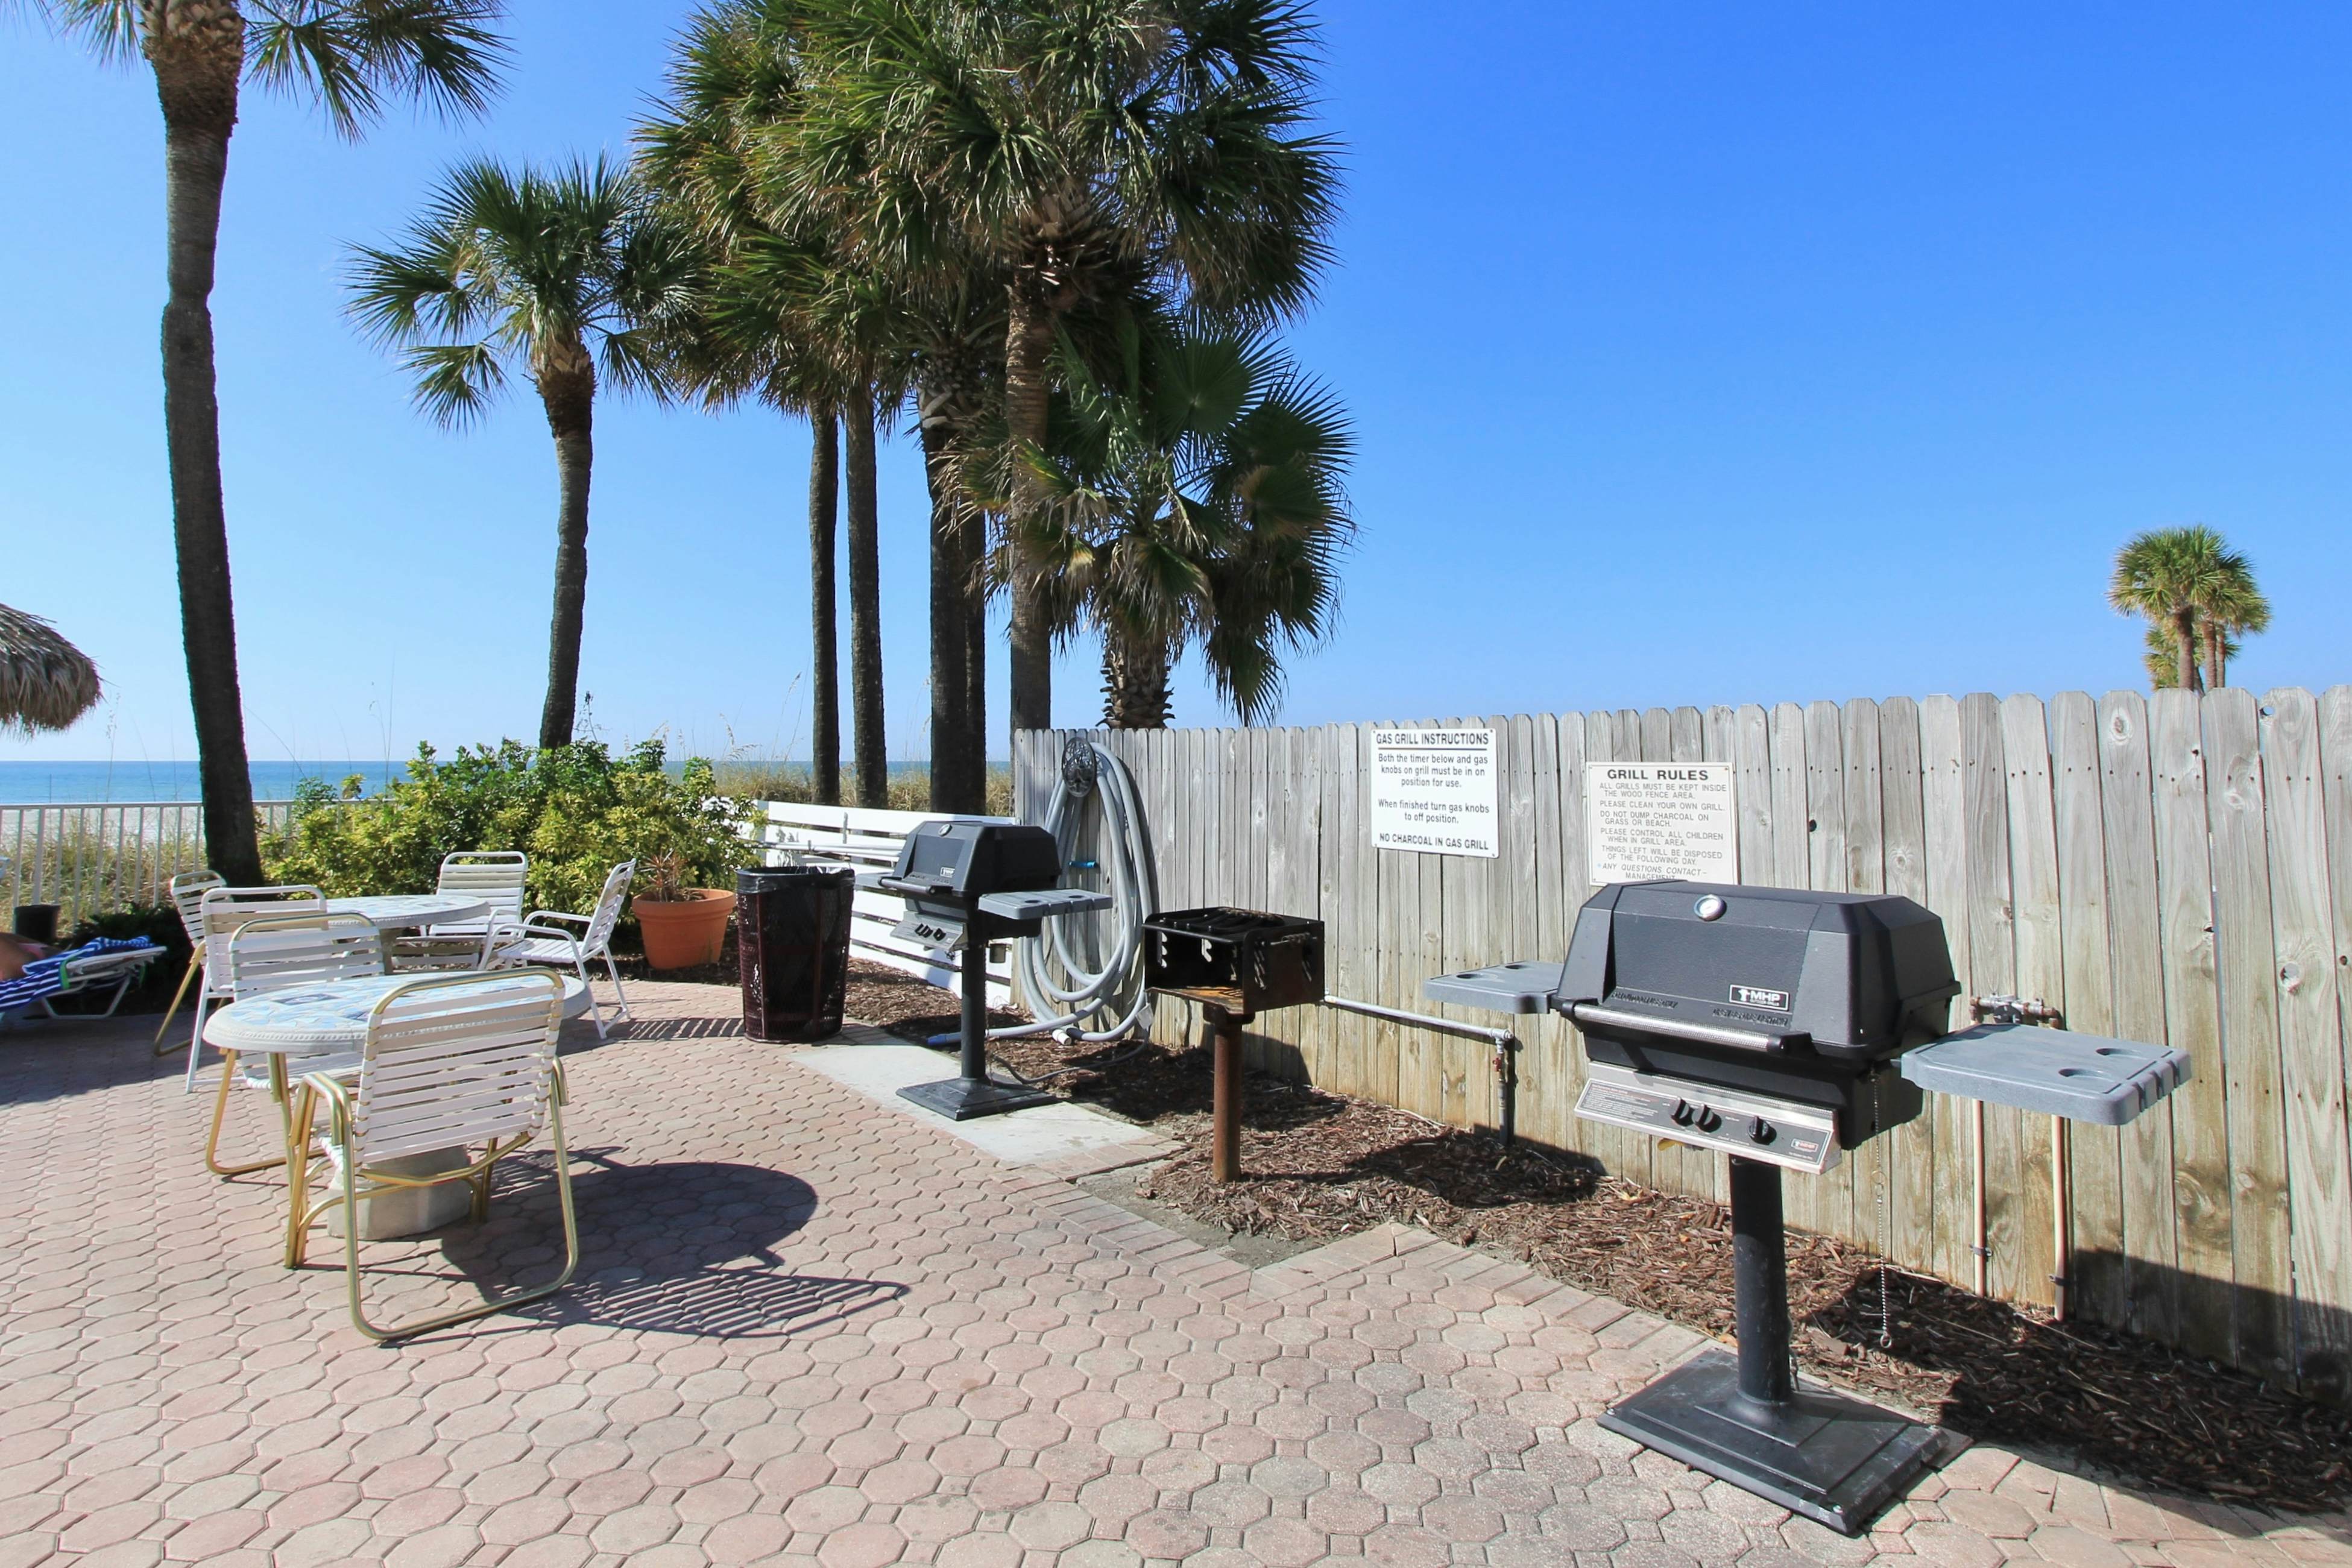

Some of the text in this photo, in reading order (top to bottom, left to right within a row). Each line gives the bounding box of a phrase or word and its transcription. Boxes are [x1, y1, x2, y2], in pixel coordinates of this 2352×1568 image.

[1376, 733, 1489, 745] GAS GRILL INSTRUCTIONS
[1378, 754, 1488, 766] Both the timer below and gas
[1381, 765, 1401, 773] knobs
[1415, 766, 1429, 776] grill
[1453, 766, 1462, 775] be
[1465, 767, 1472, 776] in
[1607, 769, 1709, 781] GRILL RULES
[1401, 778, 1430, 787] position
[1378, 799, 1489, 813] When finished turn gas knobs
[1414, 813, 1423, 821] off
[1426, 813, 1459, 823] position.
[1630, 829, 1664, 837] CONTROL
[1686, 831, 1723, 840] CHILDREN
[1379, 833, 1489, 850] NO CHARCOAL IN GAS GRILL
[1602, 845, 1626, 853] THINGS
[1684, 850, 1722, 859] DISPOSED
[1637, 855, 1679, 864] FOLLOWING
[1621, 864, 1662, 874] QUESTIONS
[1750, 990, 1780, 1002] MHP
